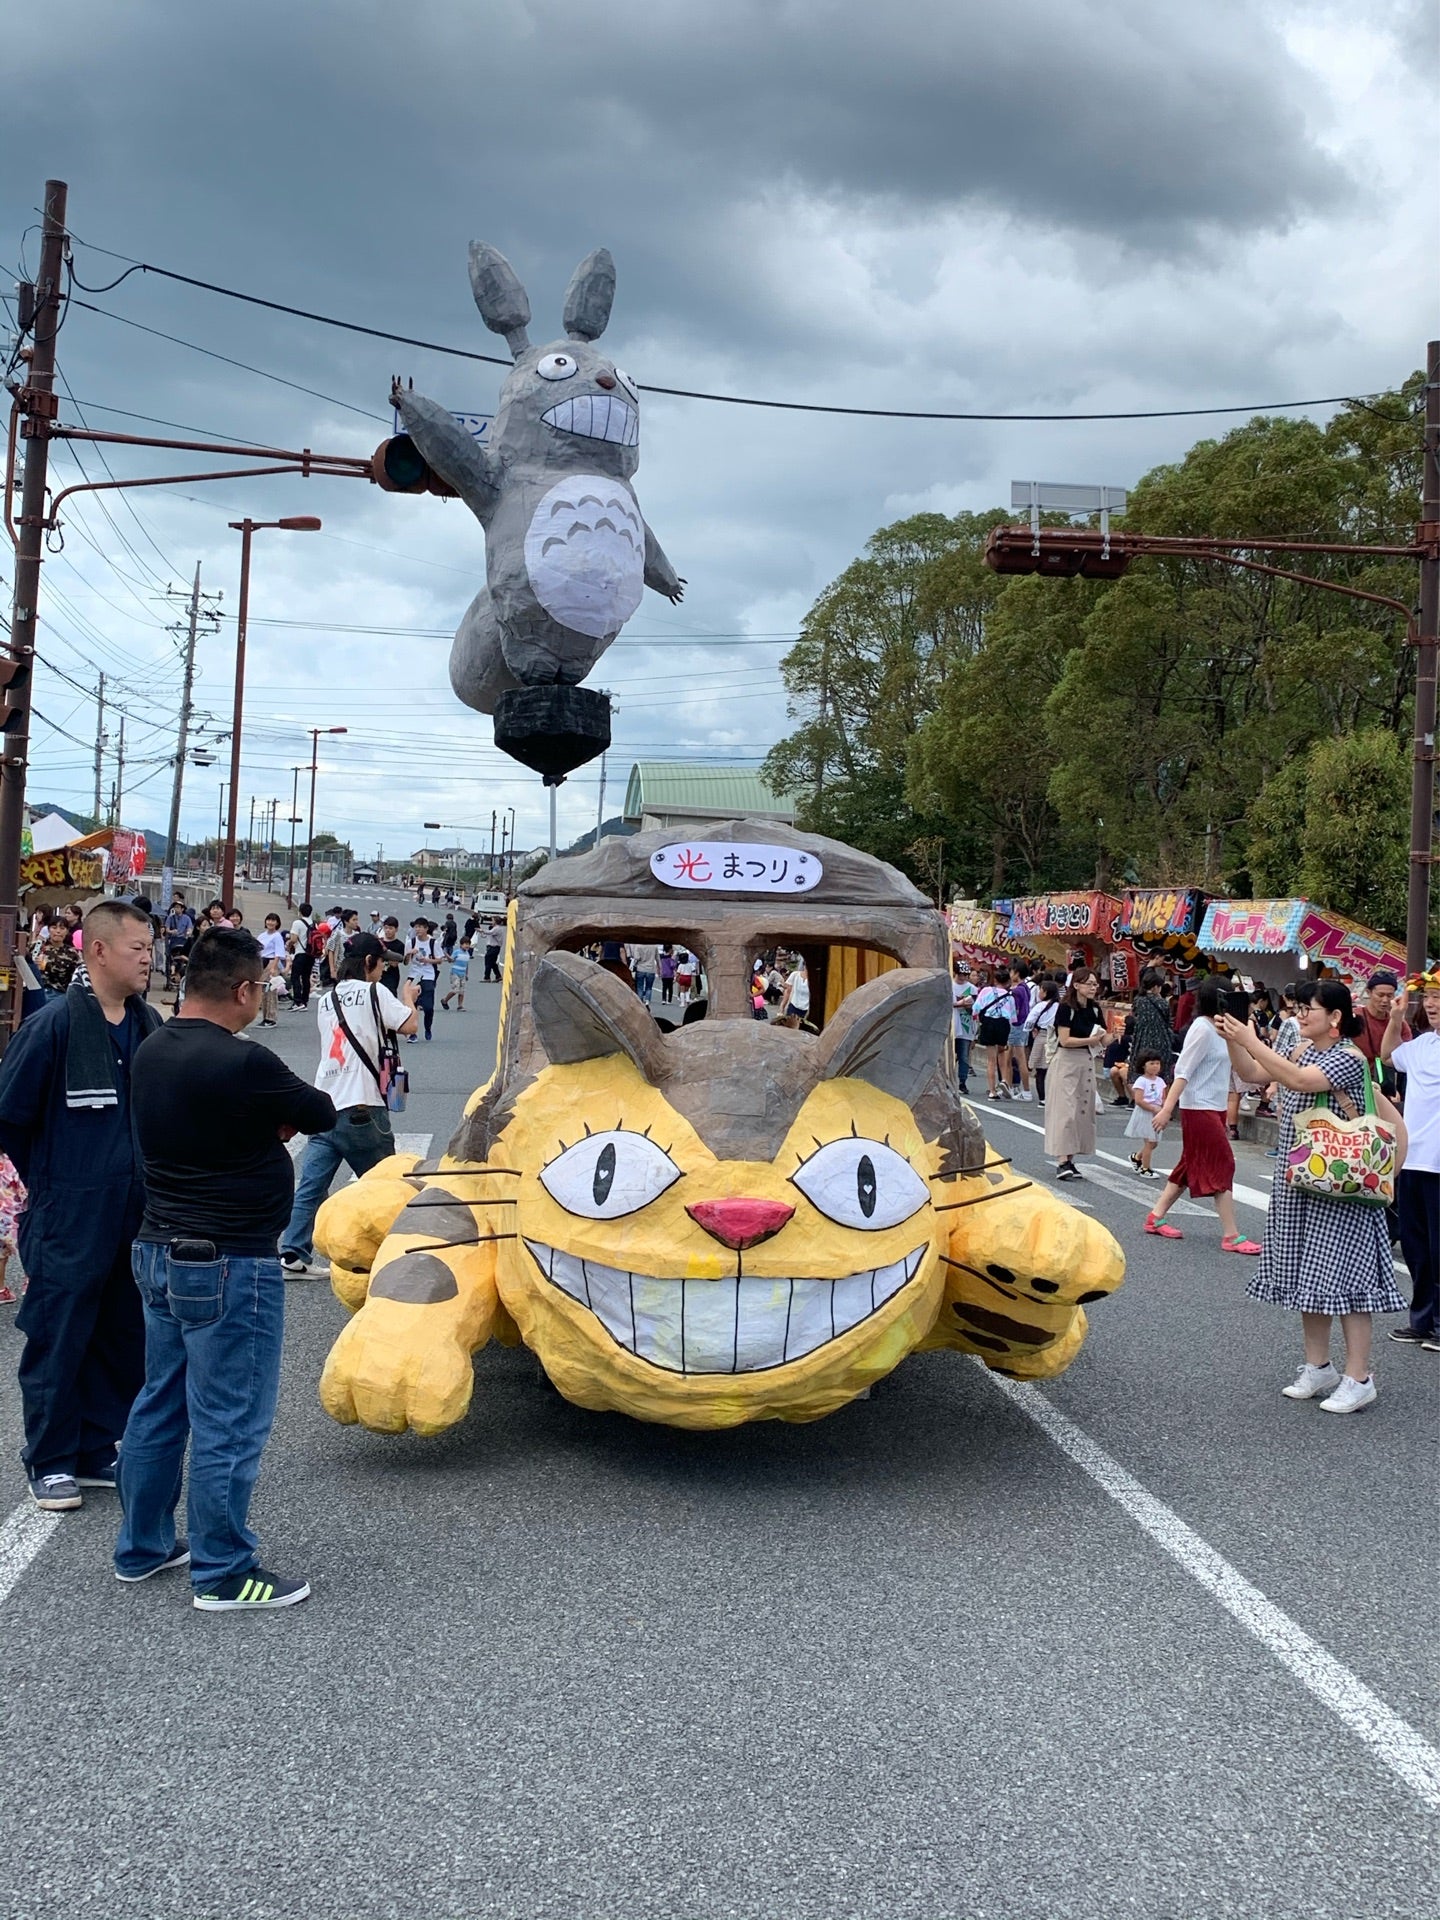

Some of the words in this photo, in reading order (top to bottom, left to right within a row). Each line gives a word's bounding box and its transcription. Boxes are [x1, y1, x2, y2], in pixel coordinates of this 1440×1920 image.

[673, 848, 788, 883] 光まつり
[1043, 904, 1091, 930] やきとり
[1210, 910, 1267, 946] クレープ
[1311, 1130, 1371, 1146] TRADER
[1320, 1145, 1362, 1159] JOE'S
